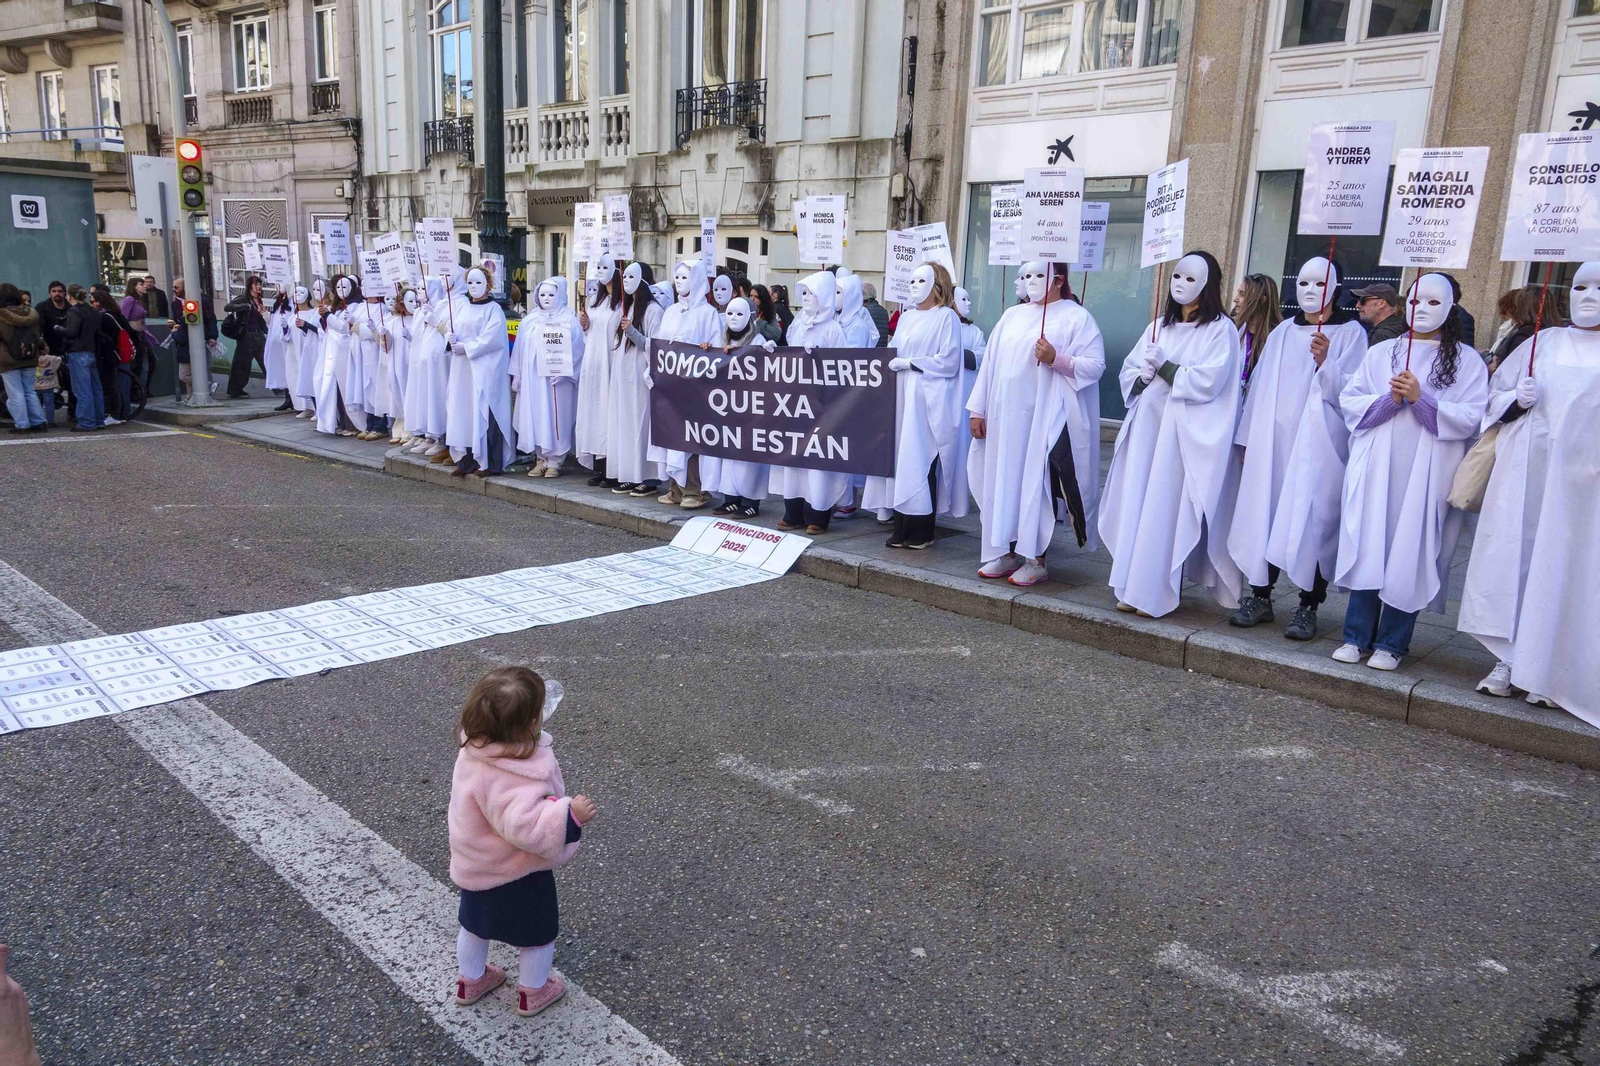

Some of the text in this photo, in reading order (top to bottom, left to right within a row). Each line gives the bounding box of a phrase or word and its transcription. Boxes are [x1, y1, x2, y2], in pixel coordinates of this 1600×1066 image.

[1326, 147, 1370, 156] ANDREA
[1327, 156, 1371, 164] YTURRY
[1529, 163, 1600, 174] CONSUELO
[1408, 171, 1469, 182] MAGALI
[1529, 174, 1596, 185] PALACIOS
[1158, 183, 1173, 196] RITA
[1327, 180, 1340, 190] 25
[1396, 184, 1474, 195] SANABRIA
[995, 200, 1020, 208] TERESA
[1330, 200, 1364, 208] CORUÑA)
[1401, 198, 1466, 209] ROMERO
[1534, 203, 1580, 213] 87 anos
[994, 208, 1022, 218] DE JESÚS
[1407, 216, 1450, 226] 29 anos
[1540, 217, 1577, 226] CORUÑA
[1528, 225, 1579, 234] (A CORUÑA)
[376, 243, 400, 255] MARITZA
[893, 245, 916, 255] ESTHER
[1404, 246, 1445, 254] (OURENSE)
[896, 253, 913, 262] GAGO
[657, 349, 882, 387] SOMOS AS MULLERES
[708, 388, 815, 419] QUE XA
[685, 420, 849, 460] NON ESTÁN
[713, 521, 782, 544] FEMINICIDIOS
[722, 540, 747, 553] 2025
